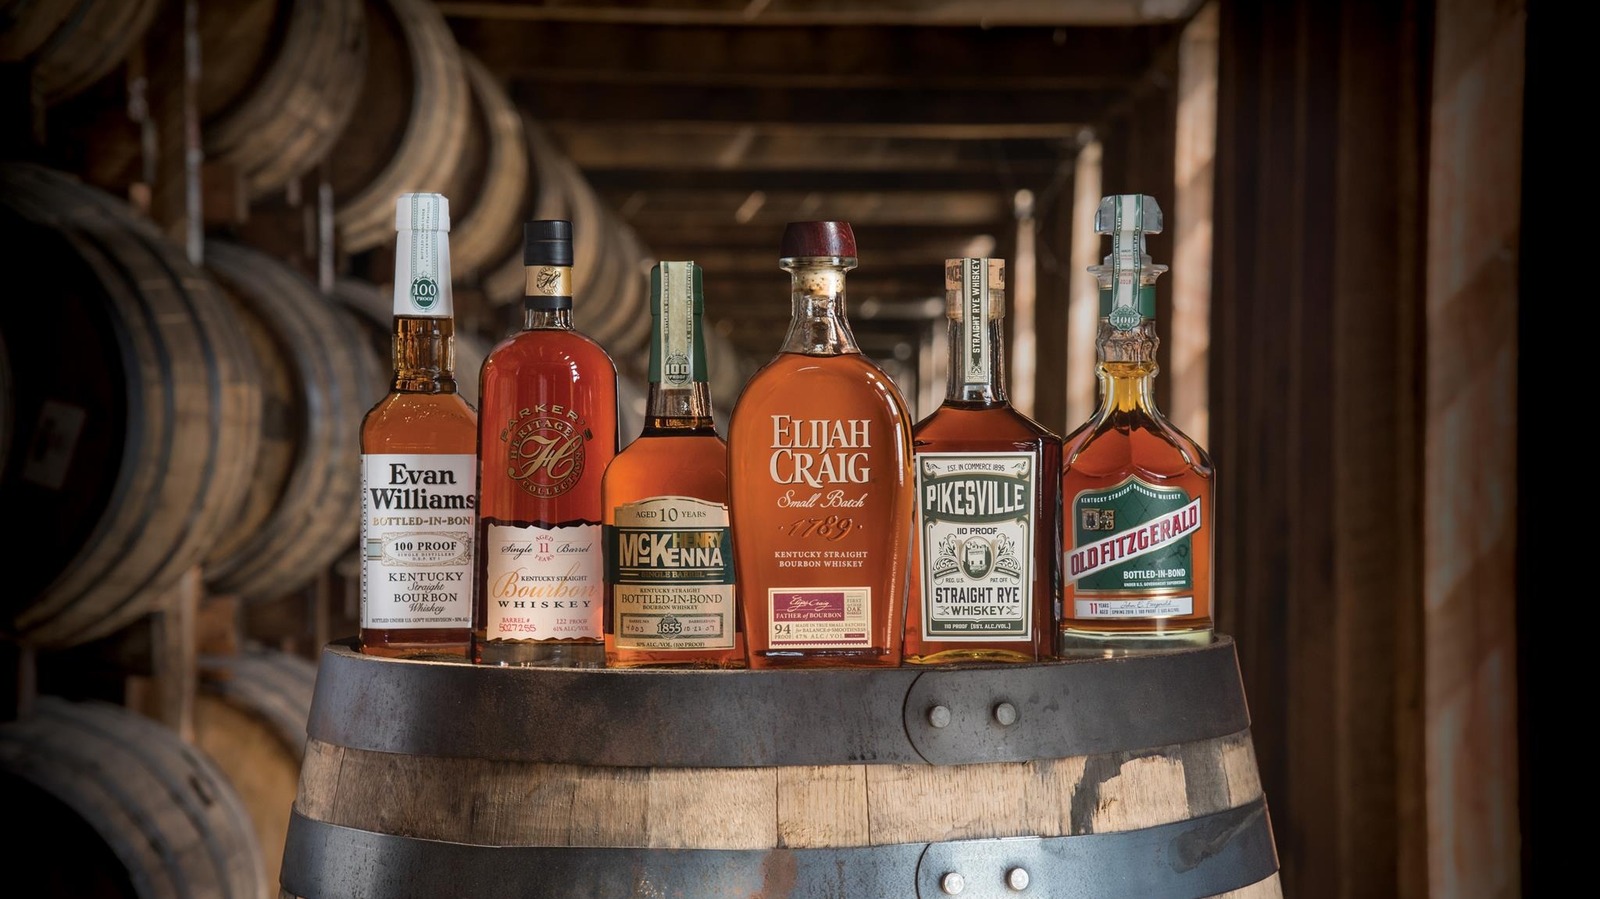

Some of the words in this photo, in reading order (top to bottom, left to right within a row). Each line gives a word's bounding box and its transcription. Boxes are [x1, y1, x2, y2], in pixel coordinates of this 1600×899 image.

[413, 284, 436, 296] 100
[665, 364, 690, 375] 100
[500, 404, 593, 442] PARKER'S
[511, 419, 573, 459] HERITAGE
[771, 415, 871, 455] ELIJAH
[388, 463, 456, 485] Evan
[523, 452, 583, 495] COLLECTION
[770, 449, 870, 488] CRAIG
[370, 488, 475, 509] Williams
[777, 490, 822, 508] Small
[820, 490, 868, 508] Batch
[926, 480, 1024, 515] PIKESVILLE
[1109, 484, 1132, 500] STRAIGHT
[1133, 484, 1156, 498] BOURBON
[372, 517, 473, 526] BOTTLED-IN-BON
[660, 508, 678, 522] 10
[788, 516, 852, 541] 1789
[394, 542, 413, 550] 100
[417, 542, 457, 550] PROOF
[673, 533, 724, 548] HENRY
[1071, 544, 1098, 576] OLD
[1100, 504, 1198, 565] FITZGERALD
[501, 543, 532, 560] Single
[540, 543, 549, 552] 11
[556, 543, 592, 553] Barrel
[389, 572, 464, 581] KENTUCKY
[492, 561, 597, 598] Bourbon
[1123, 568, 1186, 580] BOTTLED-IN-BOND
[408, 582, 445, 593] Straight
[936, 587, 992, 603] STRAIGHT
[997, 587, 1019, 603] RYE
[394, 593, 457, 602] BOURBON
[622, 594, 722, 604] BOTTLED-IN-BOND
[409, 603, 445, 615] Whiskey
[951, 606, 1005, 615] WHISKEY
[1090, 603, 1098, 614] 11
[657, 623, 682, 634] 1855
[775, 624, 791, 635] 94
